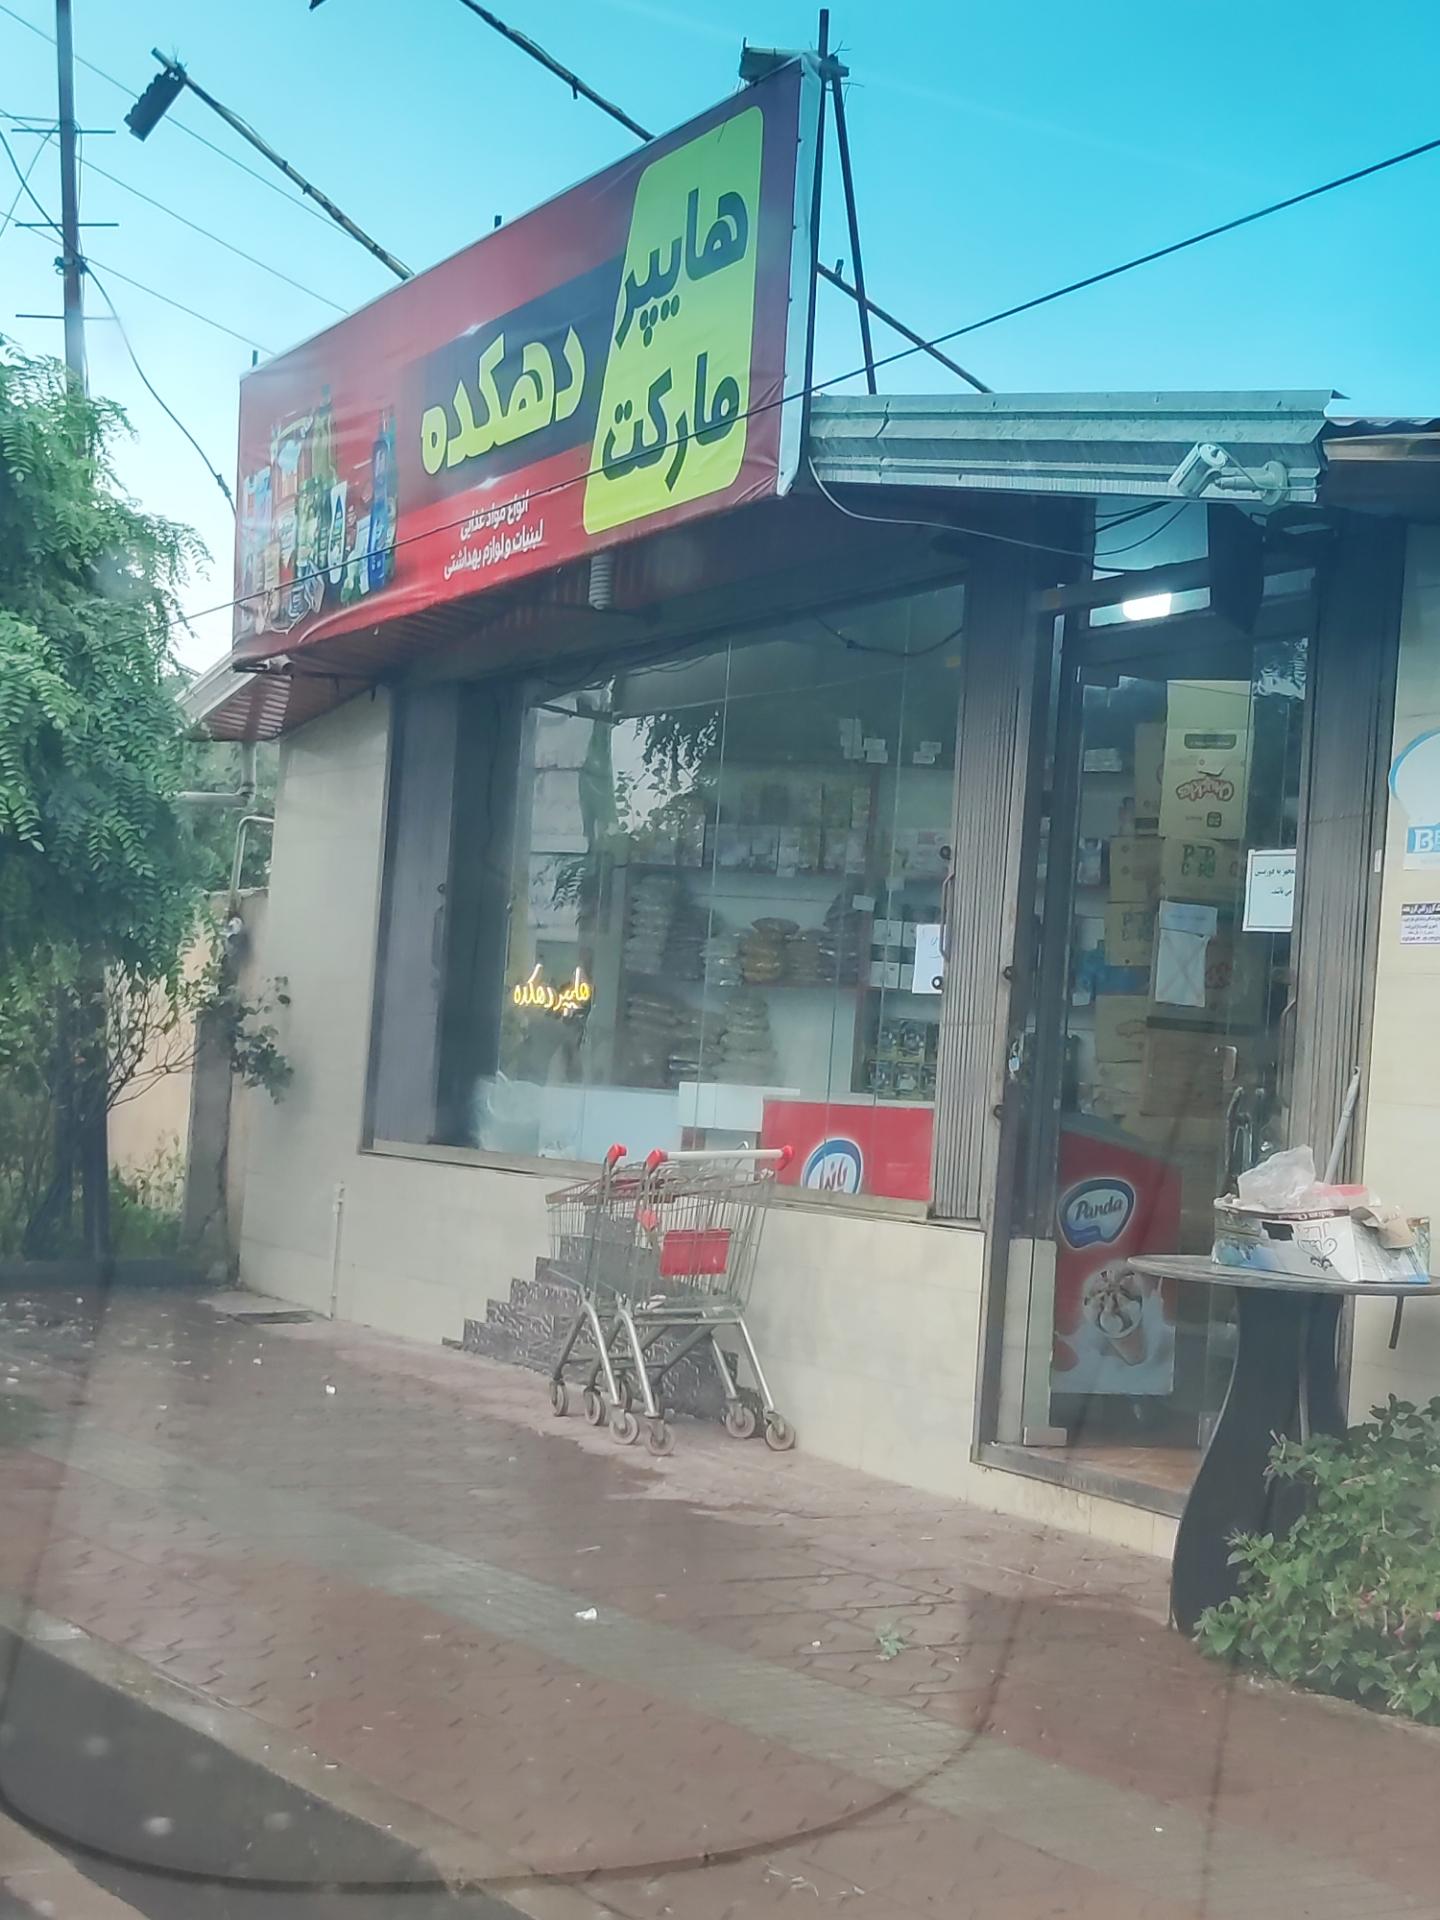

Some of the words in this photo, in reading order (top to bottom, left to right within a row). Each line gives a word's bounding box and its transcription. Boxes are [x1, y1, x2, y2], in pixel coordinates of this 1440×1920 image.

[615, 187, 749, 350] هایپر
[421, 325, 586, 476] دهکده
[602, 351, 741, 492] مارکت
[485, 502, 506, 530] مواد
[506, 488, 530, 525] انواع
[482, 532, 505, 568] لوازم
[504, 537, 512, 560] و
[512, 518, 544, 552] لبنیات
[443, 546, 482, 580] بهداشتی
[1074, 1195, 1124, 1222] Panda
